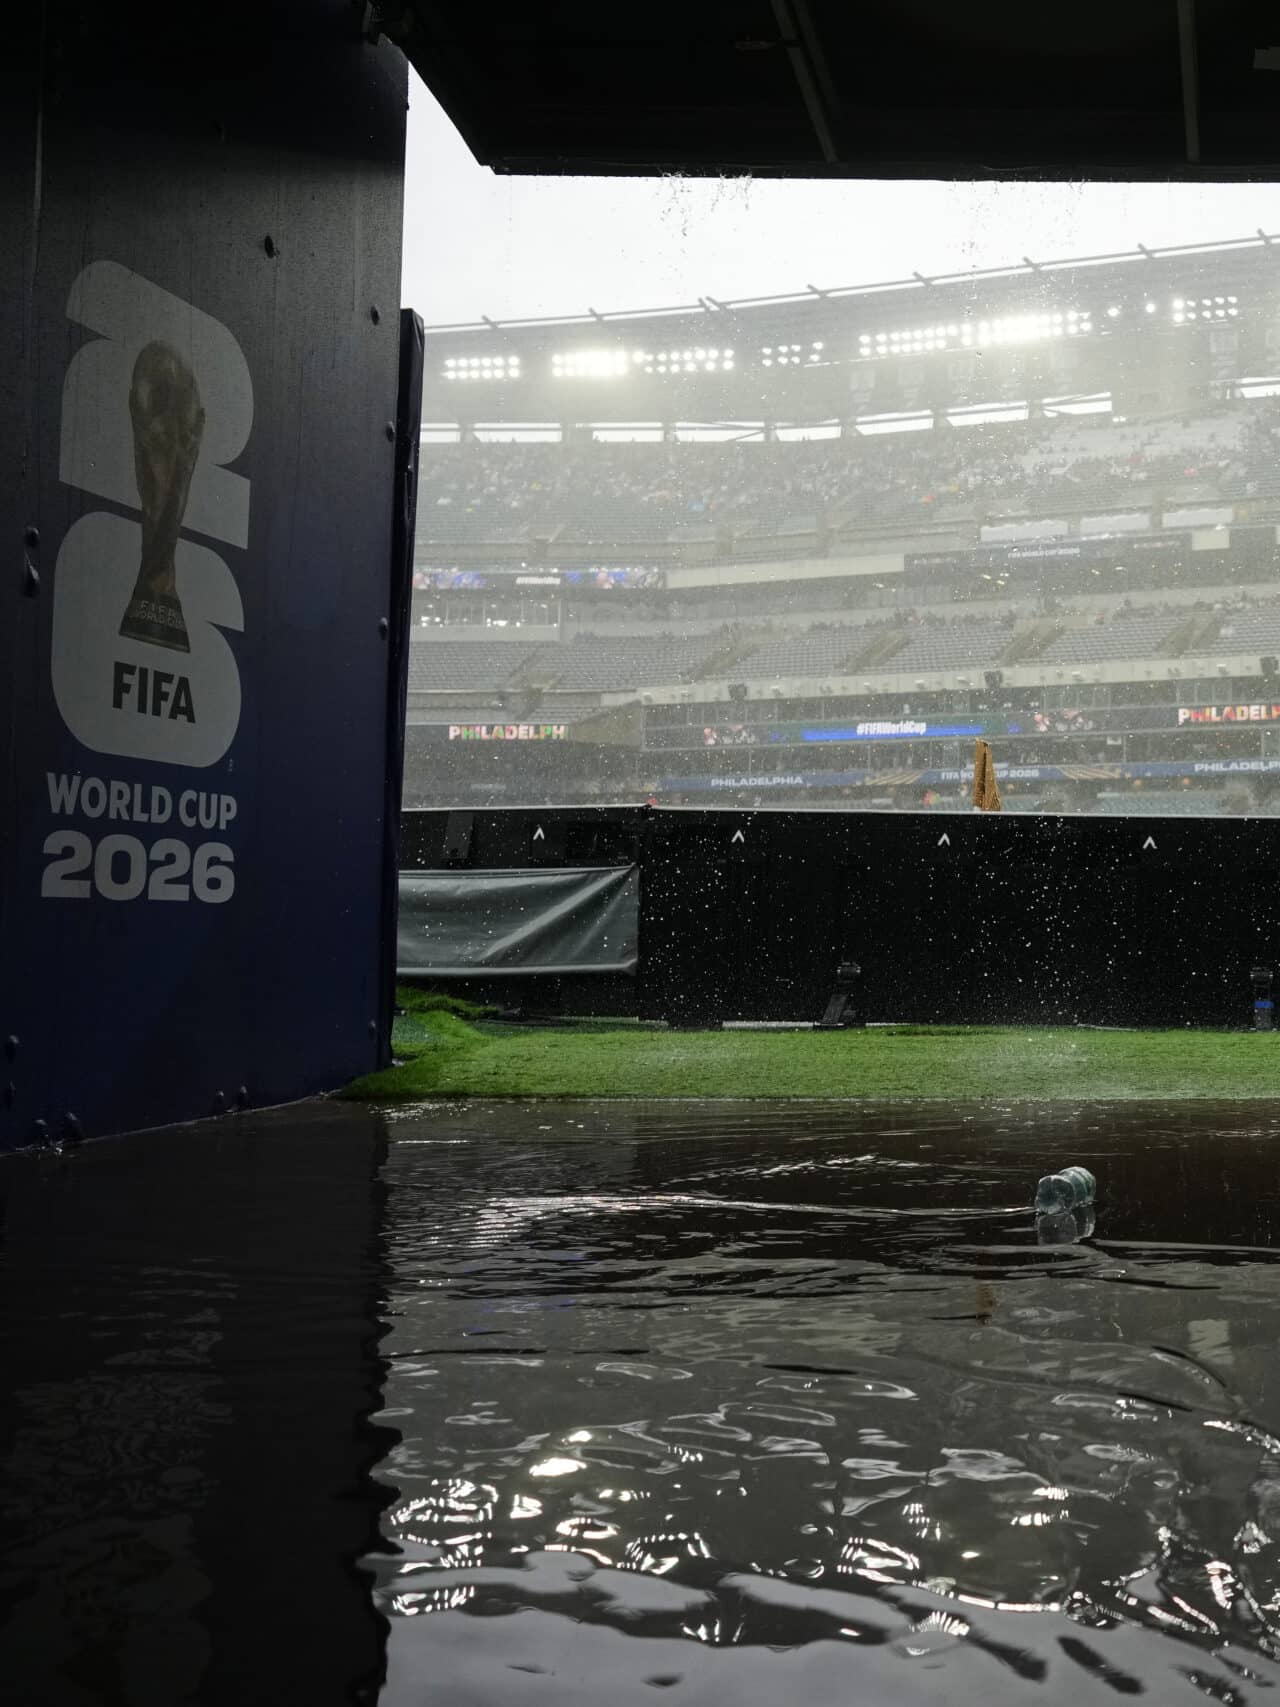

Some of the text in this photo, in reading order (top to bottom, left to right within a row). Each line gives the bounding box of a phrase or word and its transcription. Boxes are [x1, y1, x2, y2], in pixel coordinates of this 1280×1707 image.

[112, 661, 196, 724] FIFA
[46, 771, 238, 831] WORLD CUP
[711, 775, 803, 787] PHILADELPHIA
[41, 830, 236, 904] 2026
